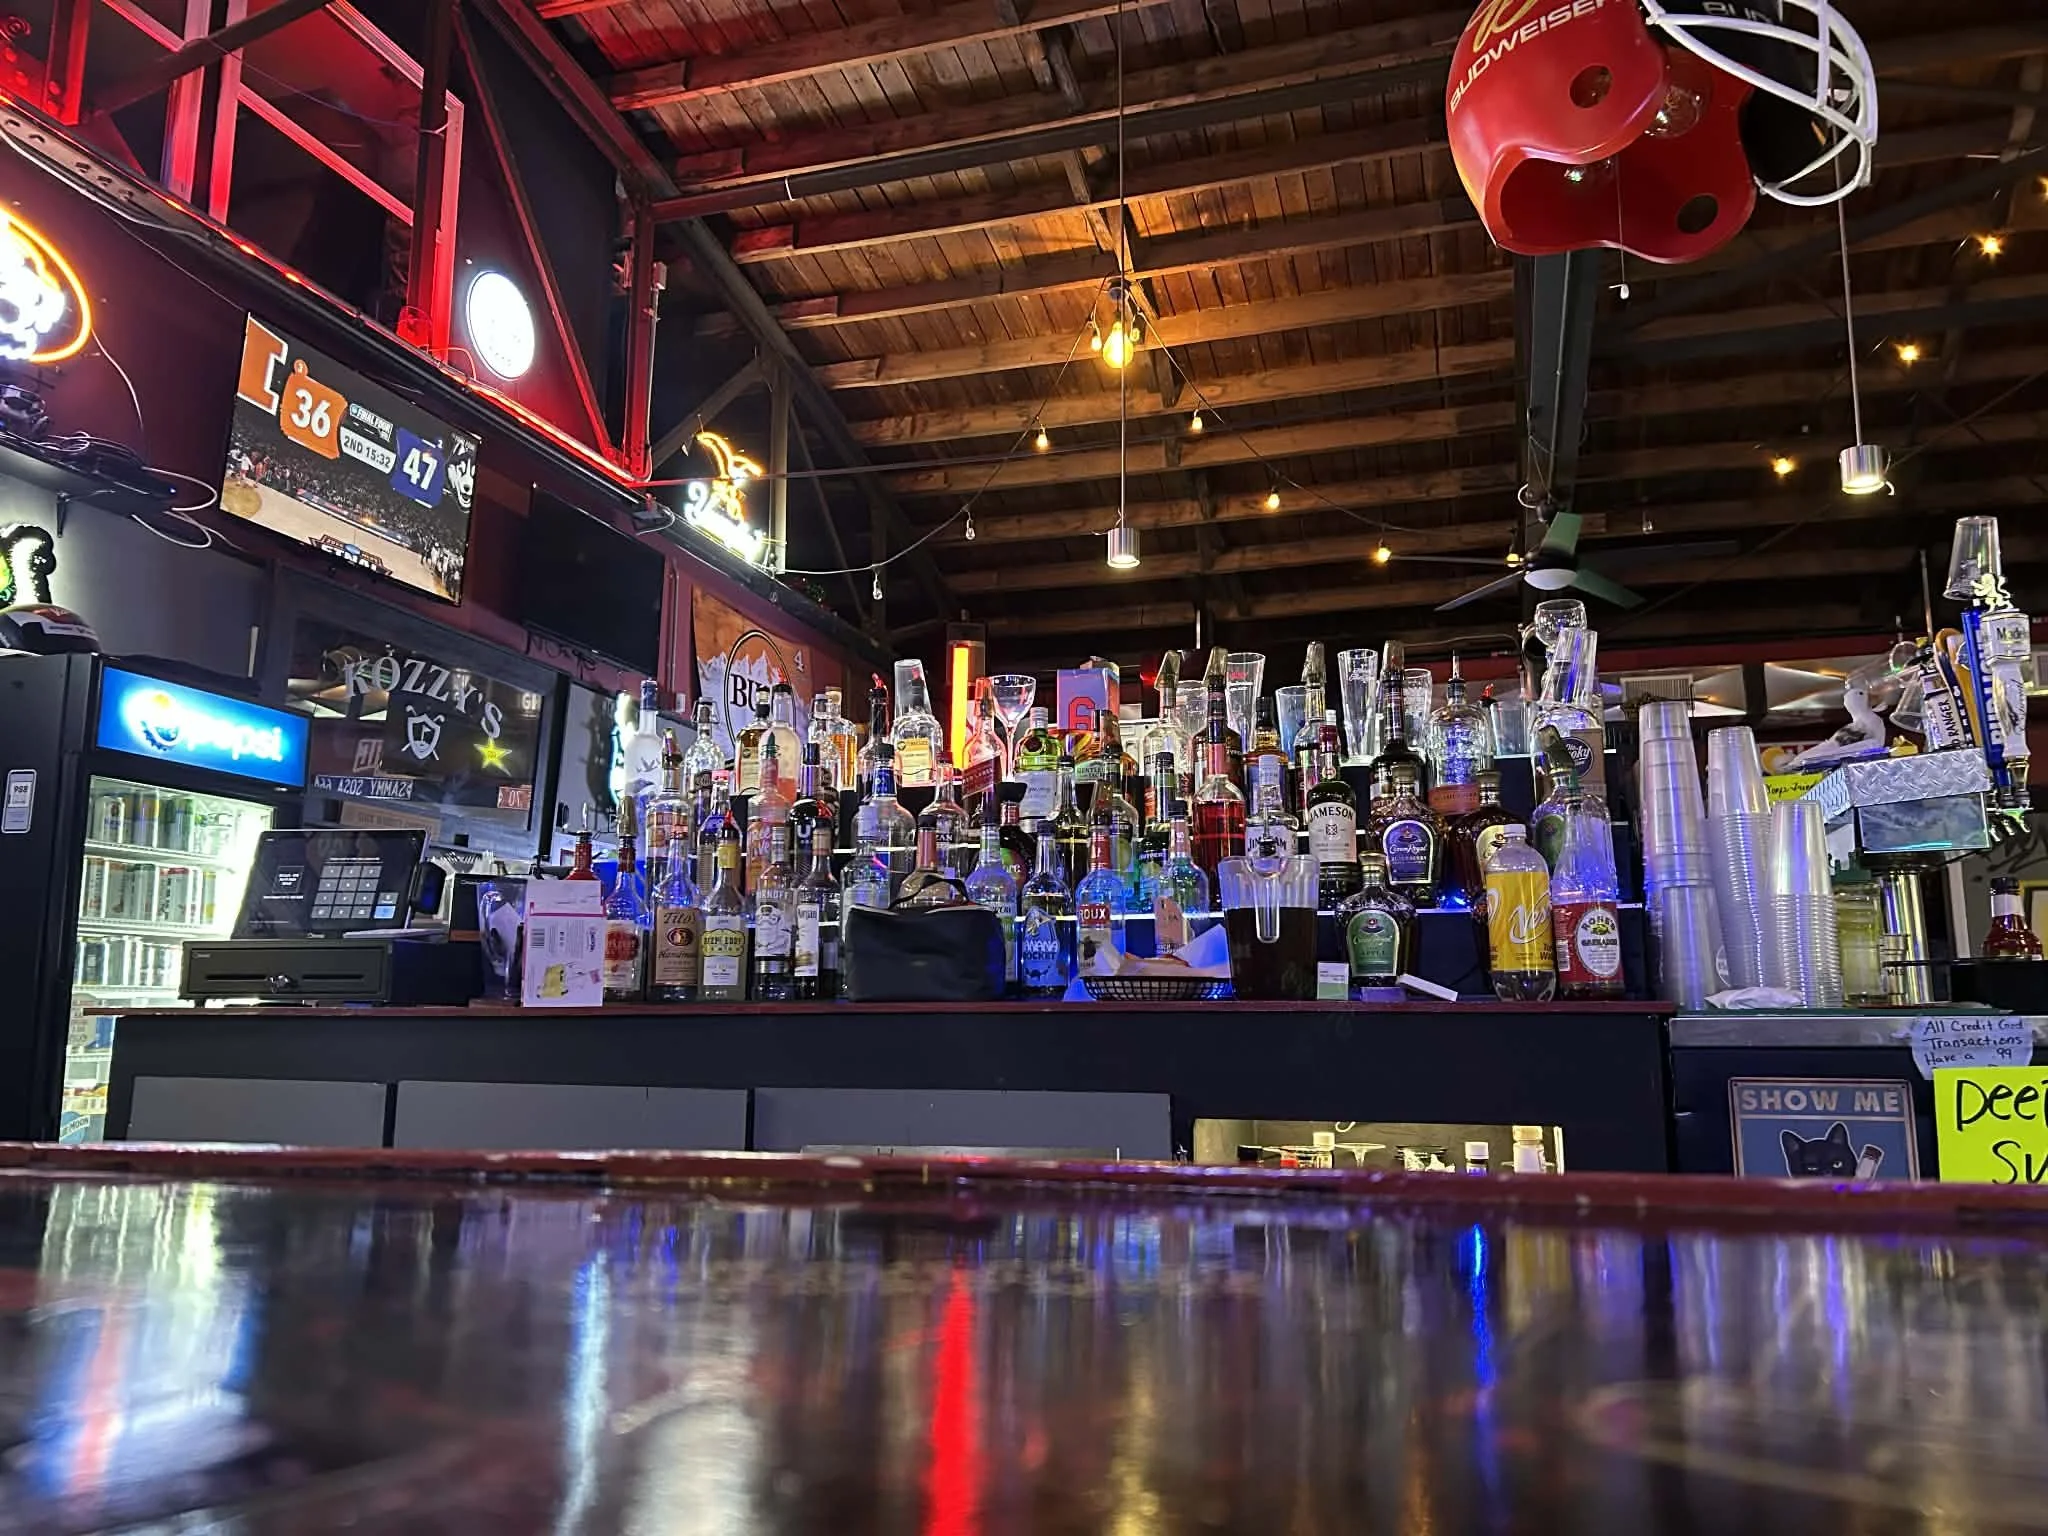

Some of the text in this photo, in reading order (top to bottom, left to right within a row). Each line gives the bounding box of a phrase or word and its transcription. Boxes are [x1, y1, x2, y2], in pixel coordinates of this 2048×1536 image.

[1450, 0, 1609, 112] BUDWEISE
[290, 389, 331, 438] 36
[343, 435, 391, 467] 2ND 15:32
[403, 447, 438, 490] 47
[344, 656, 503, 739] KOZZY'S
[1938, 699, 1959, 737] RANGER
[1310, 806, 1355, 823] JAMESON
[1922, 1036, 2024, 1050] Transactions
[1923, 1020, 1945, 1035] All
[1951, 1020, 1993, 1032] Credit
[1924, 1052, 1957, 1065] Have
[1741, 1088, 1900, 1112] SHOW ME
